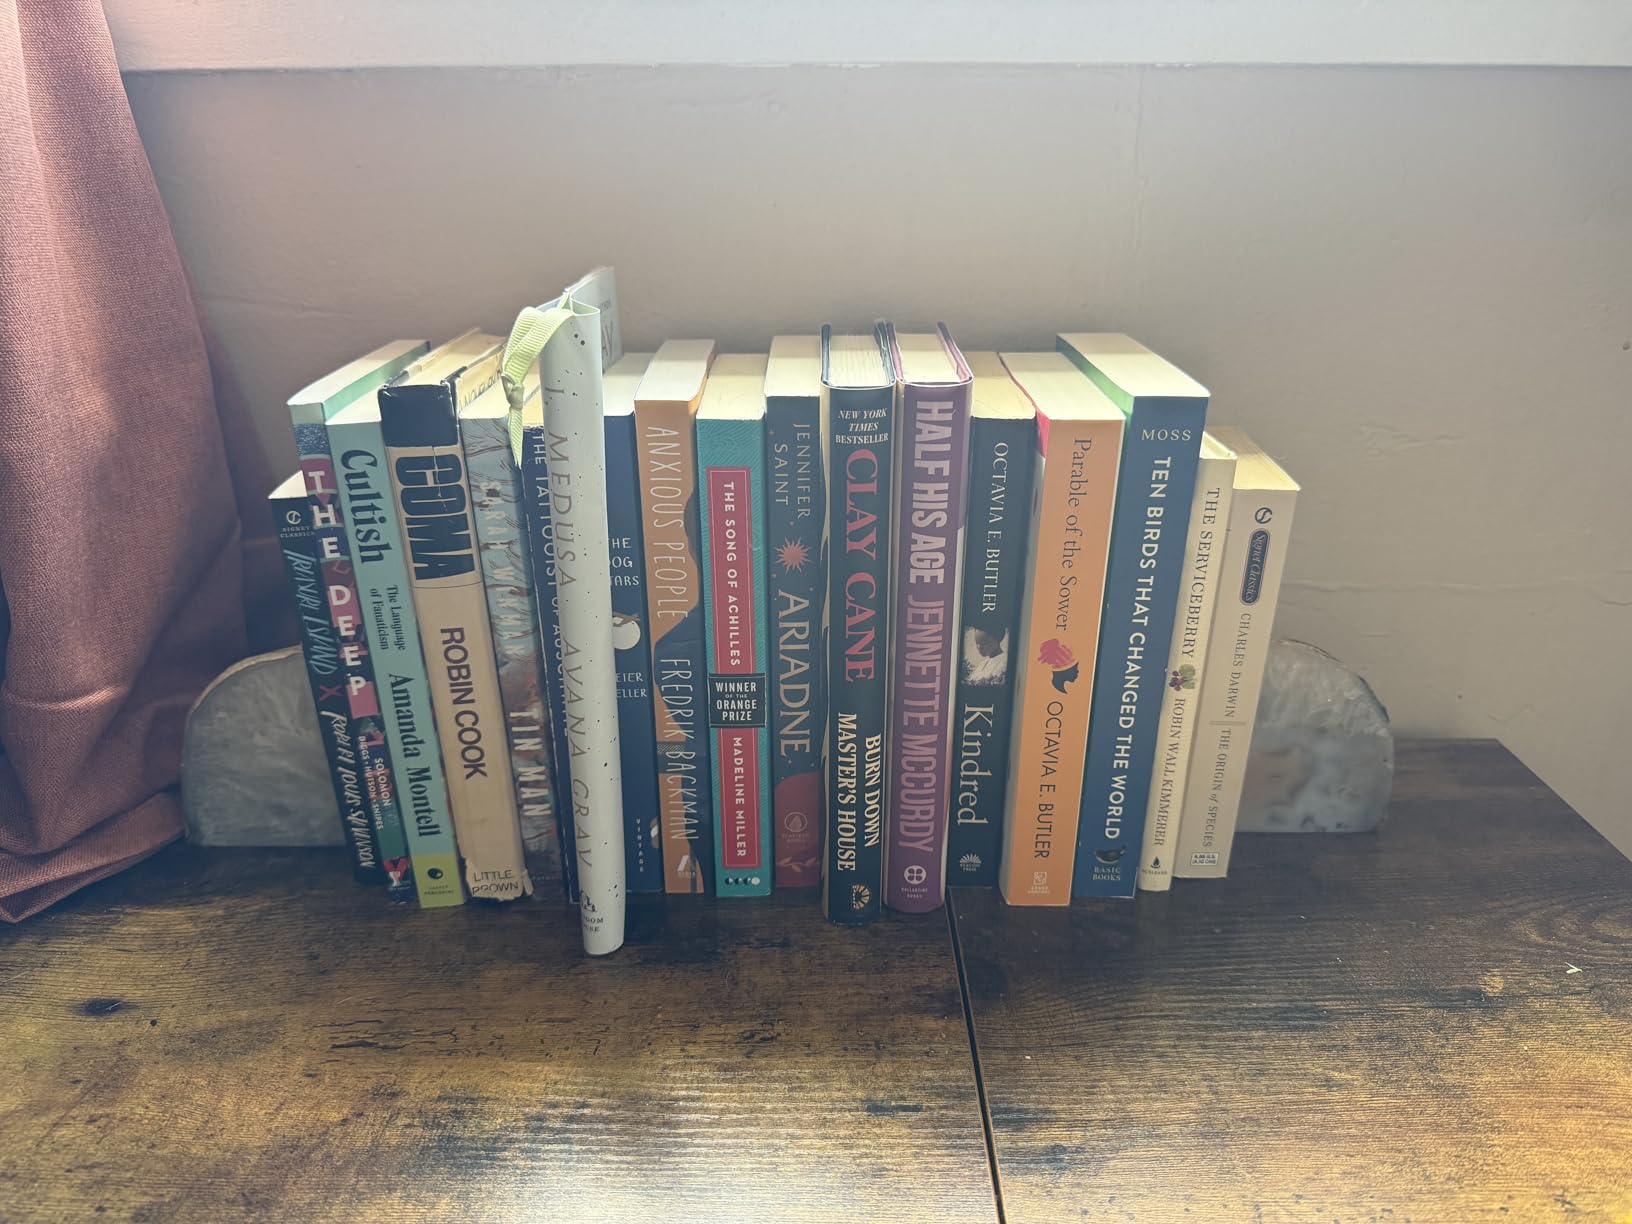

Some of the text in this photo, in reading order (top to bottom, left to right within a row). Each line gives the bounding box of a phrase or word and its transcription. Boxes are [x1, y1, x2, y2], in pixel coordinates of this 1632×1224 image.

[533, 433, 547, 464] THE
[836, 433, 888, 444] BESTSELLER
[838, 408, 888, 419] NEW YORK
[849, 422, 879, 432] TIMES
[1142, 429, 1191, 441] MOSS
[340, 450, 392, 565] Cultish
[548, 430, 577, 587] MEDUSA
[774, 443, 789, 506] SAINT
[793, 424, 811, 519] JENNIFER
[909, 400, 954, 585] HALF HIS AGE
[535, 476, 557, 586] TATTOOIST
[608, 538, 631, 548] HE
[610, 557, 633, 568] OG
[645, 427, 688, 618] ANXIOUS PEOPLE
[844, 449, 879, 682] CLAY CANE
[982, 442, 1009, 613] OCTAVIA E. BUTLER
[1056, 438, 1092, 631] Parable of the Sower
[308, 470, 366, 696] THE DEEP
[370, 588, 389, 650] of Fanaticism
[386, 585, 405, 651] The Language
[611, 575, 640, 586] TARS
[723, 481, 740, 666] THE SONG OF ACHILLES
[1181, 488, 1220, 658] THE SERVICEBERRY
[616, 672, 644, 682] ETER
[616, 688, 647, 698] ELLER
[715, 682, 757, 692] WINNER
[778, 589, 811, 757] ARIADNE
[1105, 456, 1171, 839] TEN BIRDS THAT CHANGED THE WORLD
[1225, 613, 1251, 718] CHARLES DARWIN
[440, 627, 488, 780] ROBIN COOK
[660, 659, 695, 740] FREDRIK
[716, 699, 757, 710] ORANGE
[722, 711, 752, 720] PRIZE
[898, 593, 945, 852] JENNETTE MCCURDY
[1219, 728, 1232, 750] THE
[357, 736, 383, 830] DIGGS HUTSON SNIPES
[374, 757, 391, 806] SOLOMON
[389, 674, 442, 837] Amanda Montell
[510, 711, 551, 816] TIN MAN
[665, 751, 699, 840] BACKMAN
[733, 736, 746, 857] MADELINE MILLER
[837, 712, 857, 871] MASTER'S HOUSE
[863, 734, 881, 848] BURN DOWN
[957, 703, 994, 826] Kindred
[1034, 701, 1063, 859] OCTAVIA E. BUTLER
[1153, 698, 1186, 846] ROBIN WALL KIMMERER
[1209, 793, 1220, 803] of
[1214, 753, 1227, 791] ORIGIN
[1202, 806, 1218, 847] SPECIES
[473, 870, 513, 881] LITTLE
